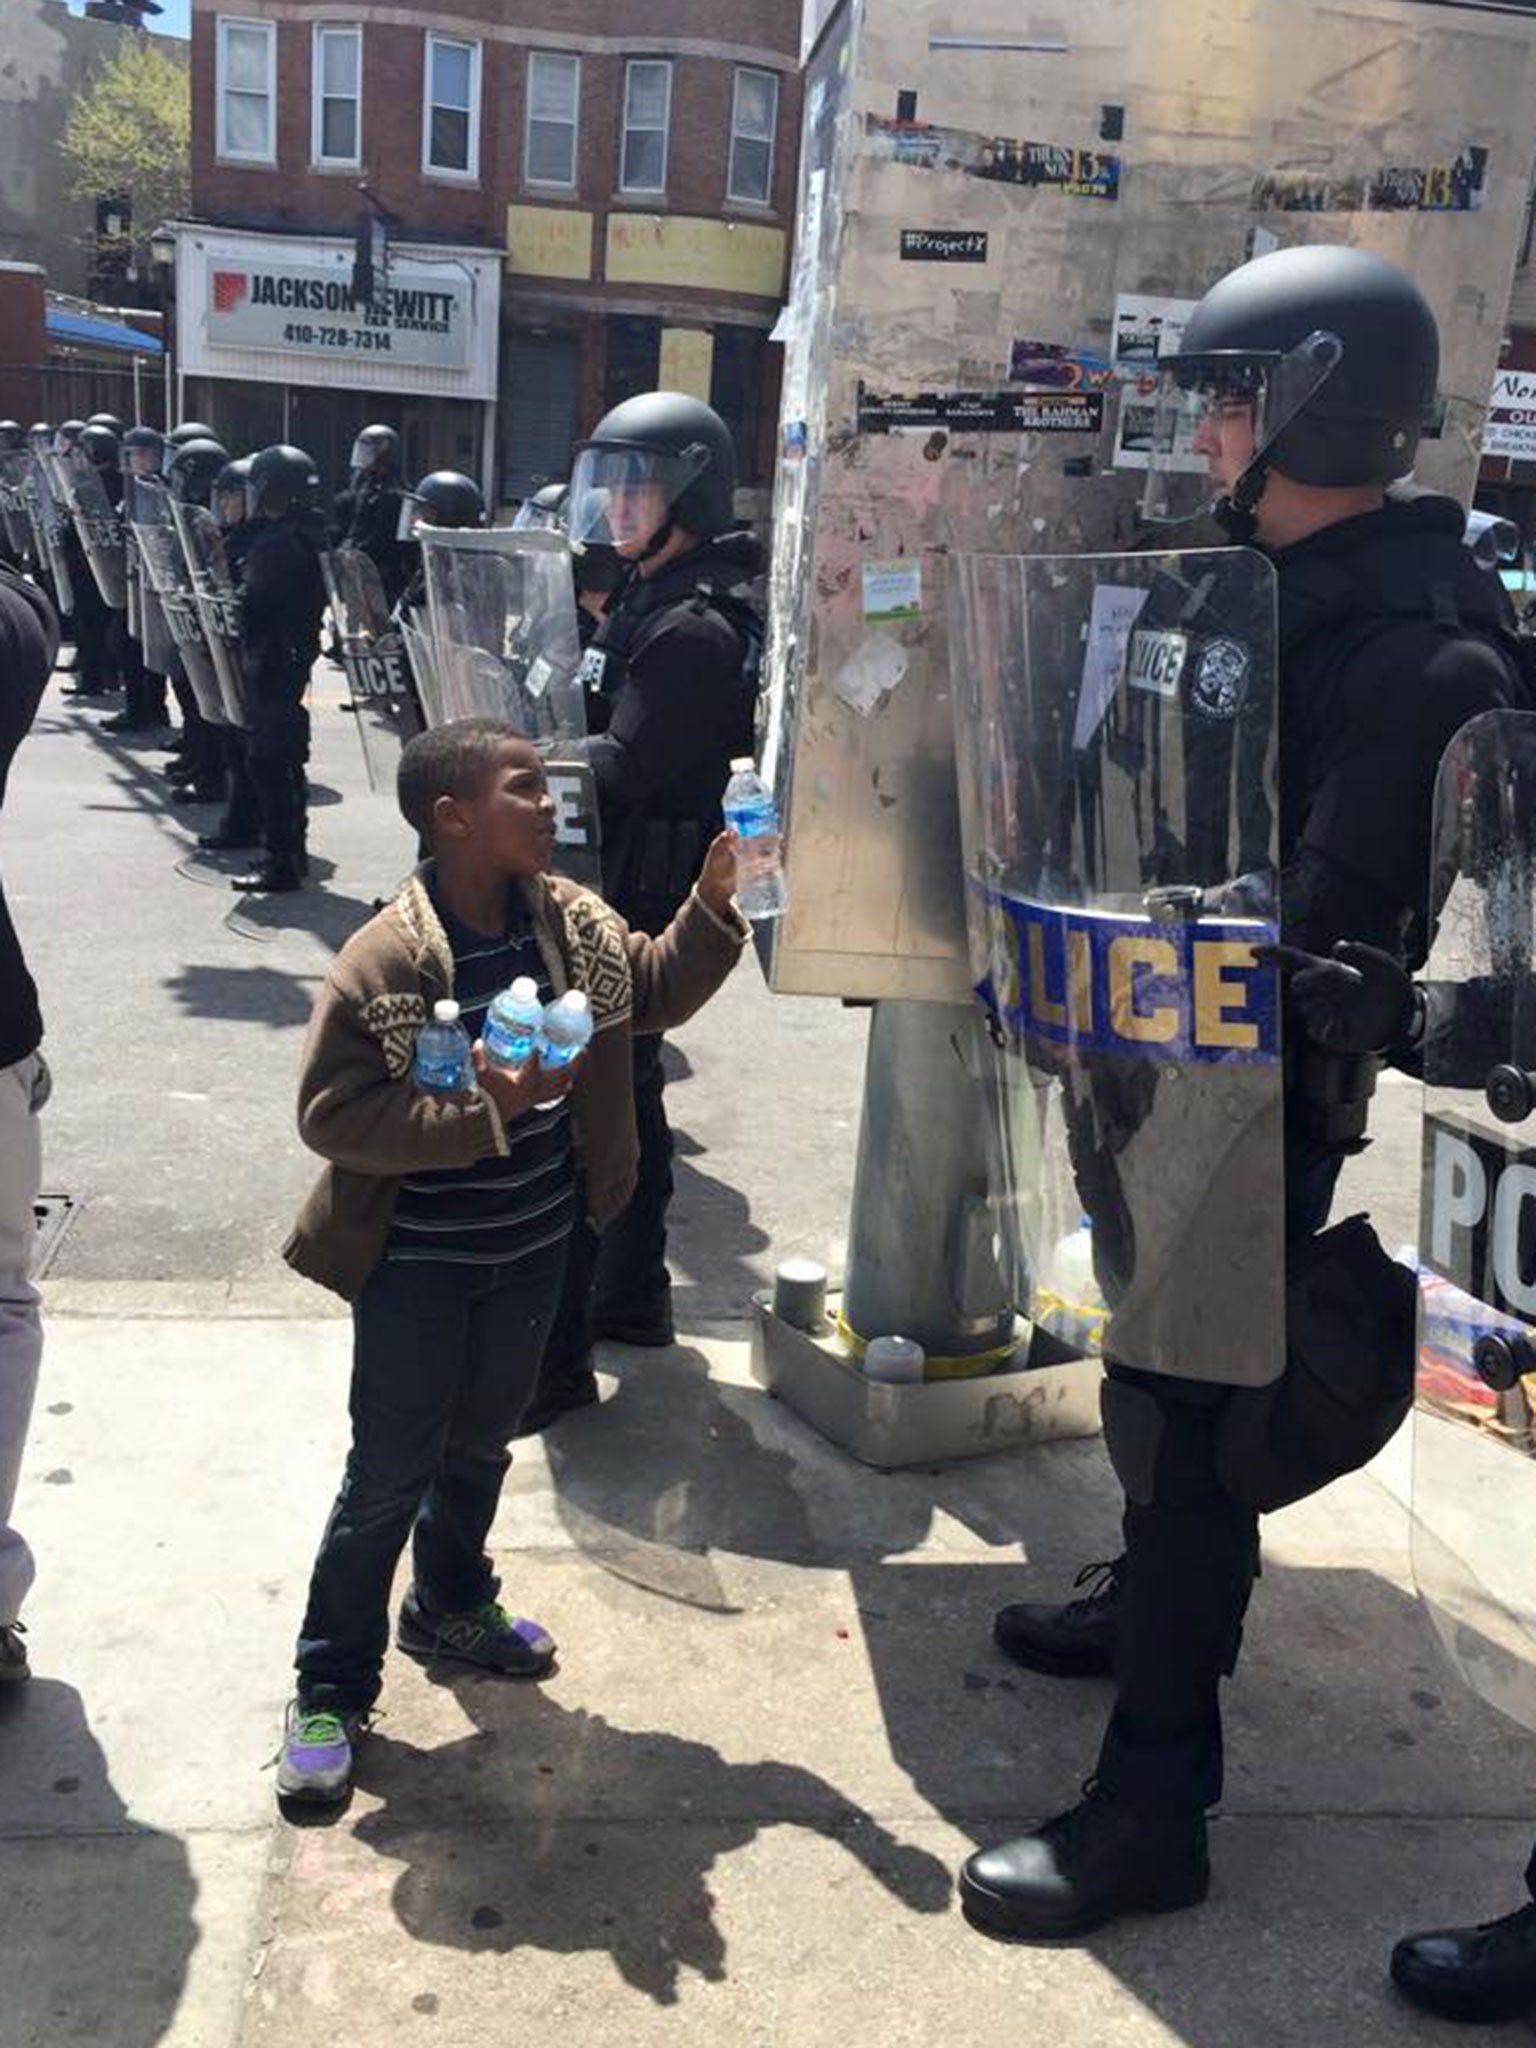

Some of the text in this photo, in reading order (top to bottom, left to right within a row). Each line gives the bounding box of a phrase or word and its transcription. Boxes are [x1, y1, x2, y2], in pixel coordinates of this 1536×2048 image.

[251, 275, 356, 313] JACKSON
[394, 318, 450, 334] SERVICE
[1013, 405, 1038, 417] THE
[1023, 416, 1092, 428] BROTHERS
[547, 776, 588, 844] E
